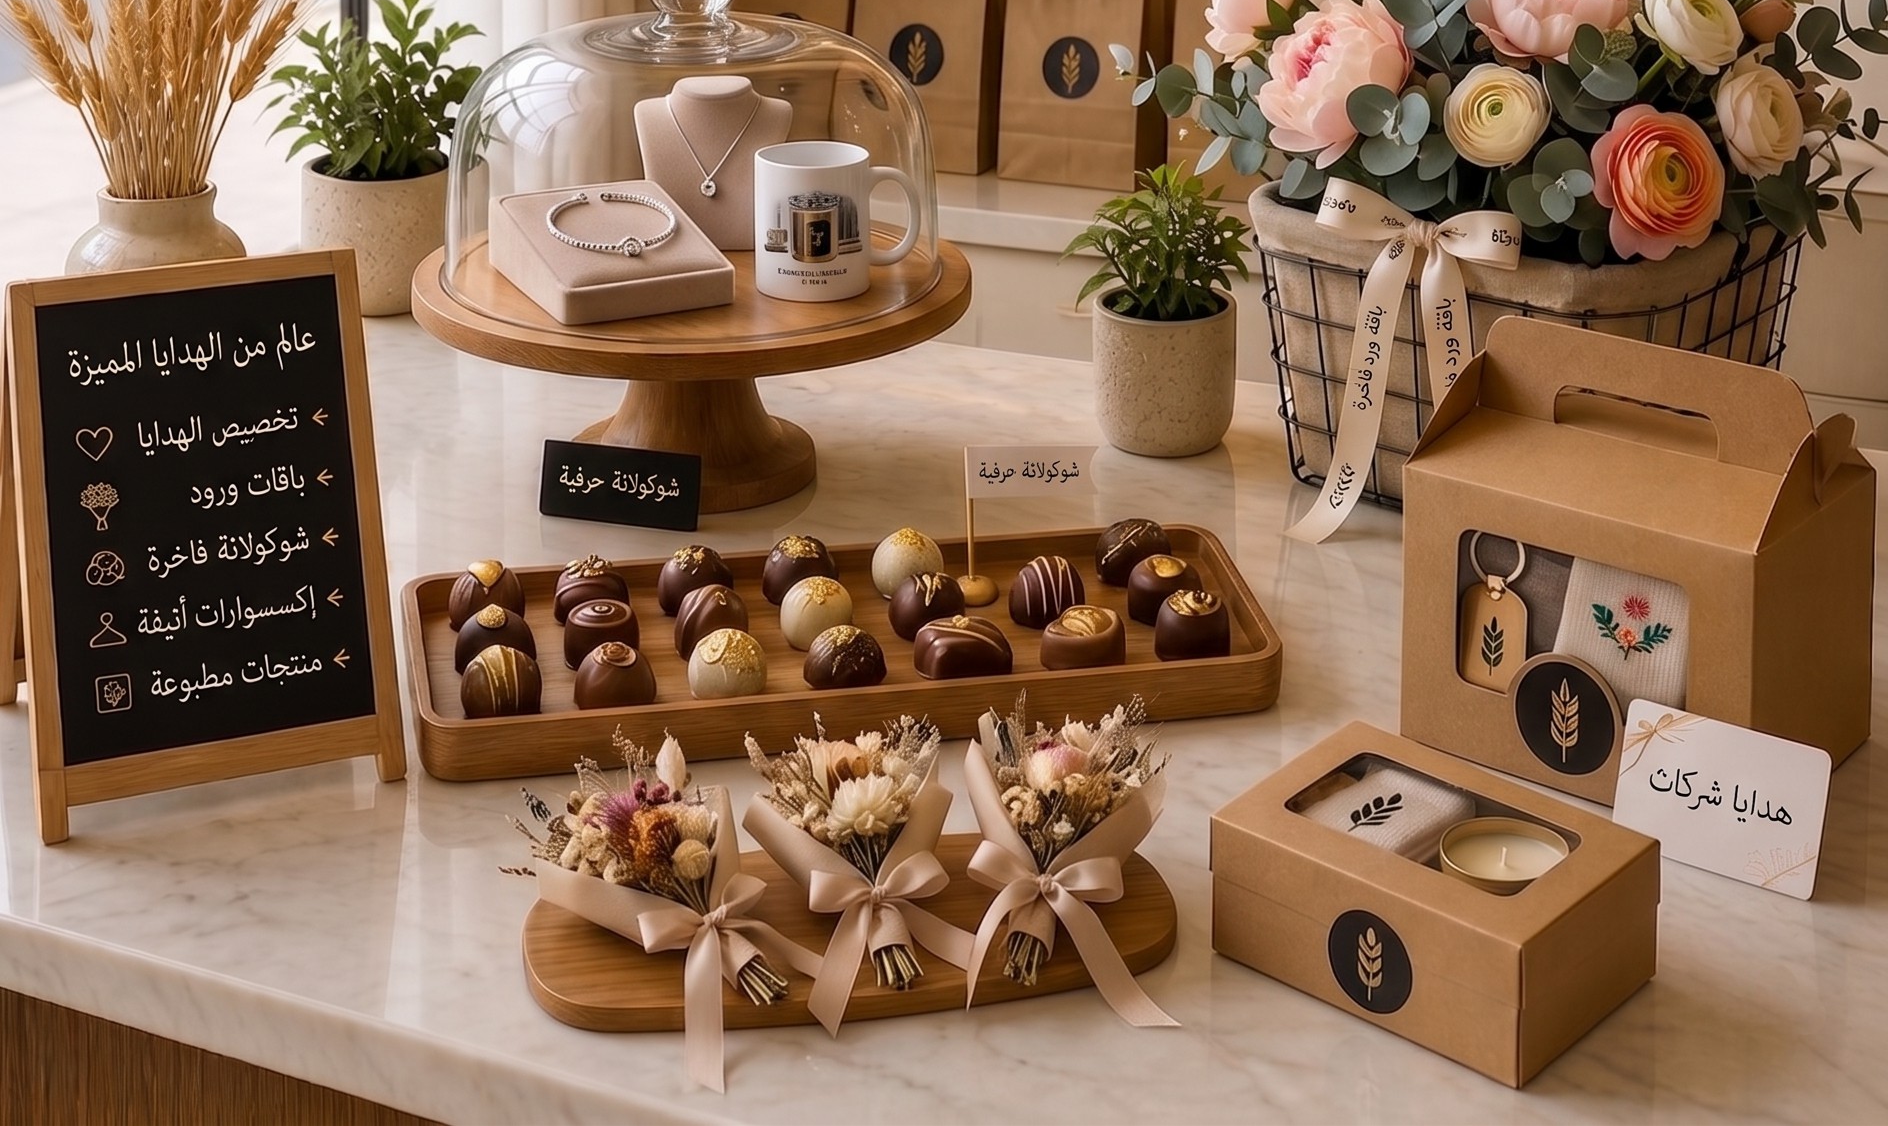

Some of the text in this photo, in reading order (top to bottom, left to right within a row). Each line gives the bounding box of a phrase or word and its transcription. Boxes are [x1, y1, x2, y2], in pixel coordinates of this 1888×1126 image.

[69, 323, 315, 385] عالم من الهدايا المميزة
[1366, 342, 1380, 365] ورد
[1446, 338, 1460, 366] ورد
[138, 416, 201, 456] الهدايا
[191, 465, 304, 509] باقات ورود
[560, 465, 604, 493] حرفية
[148, 540, 207, 578] فاخرة
[196, 585, 316, 628] إكسسوارات
[151, 654, 322, 702] منتجات مطبوعة
[1734, 785, 1792, 825] هدايا
